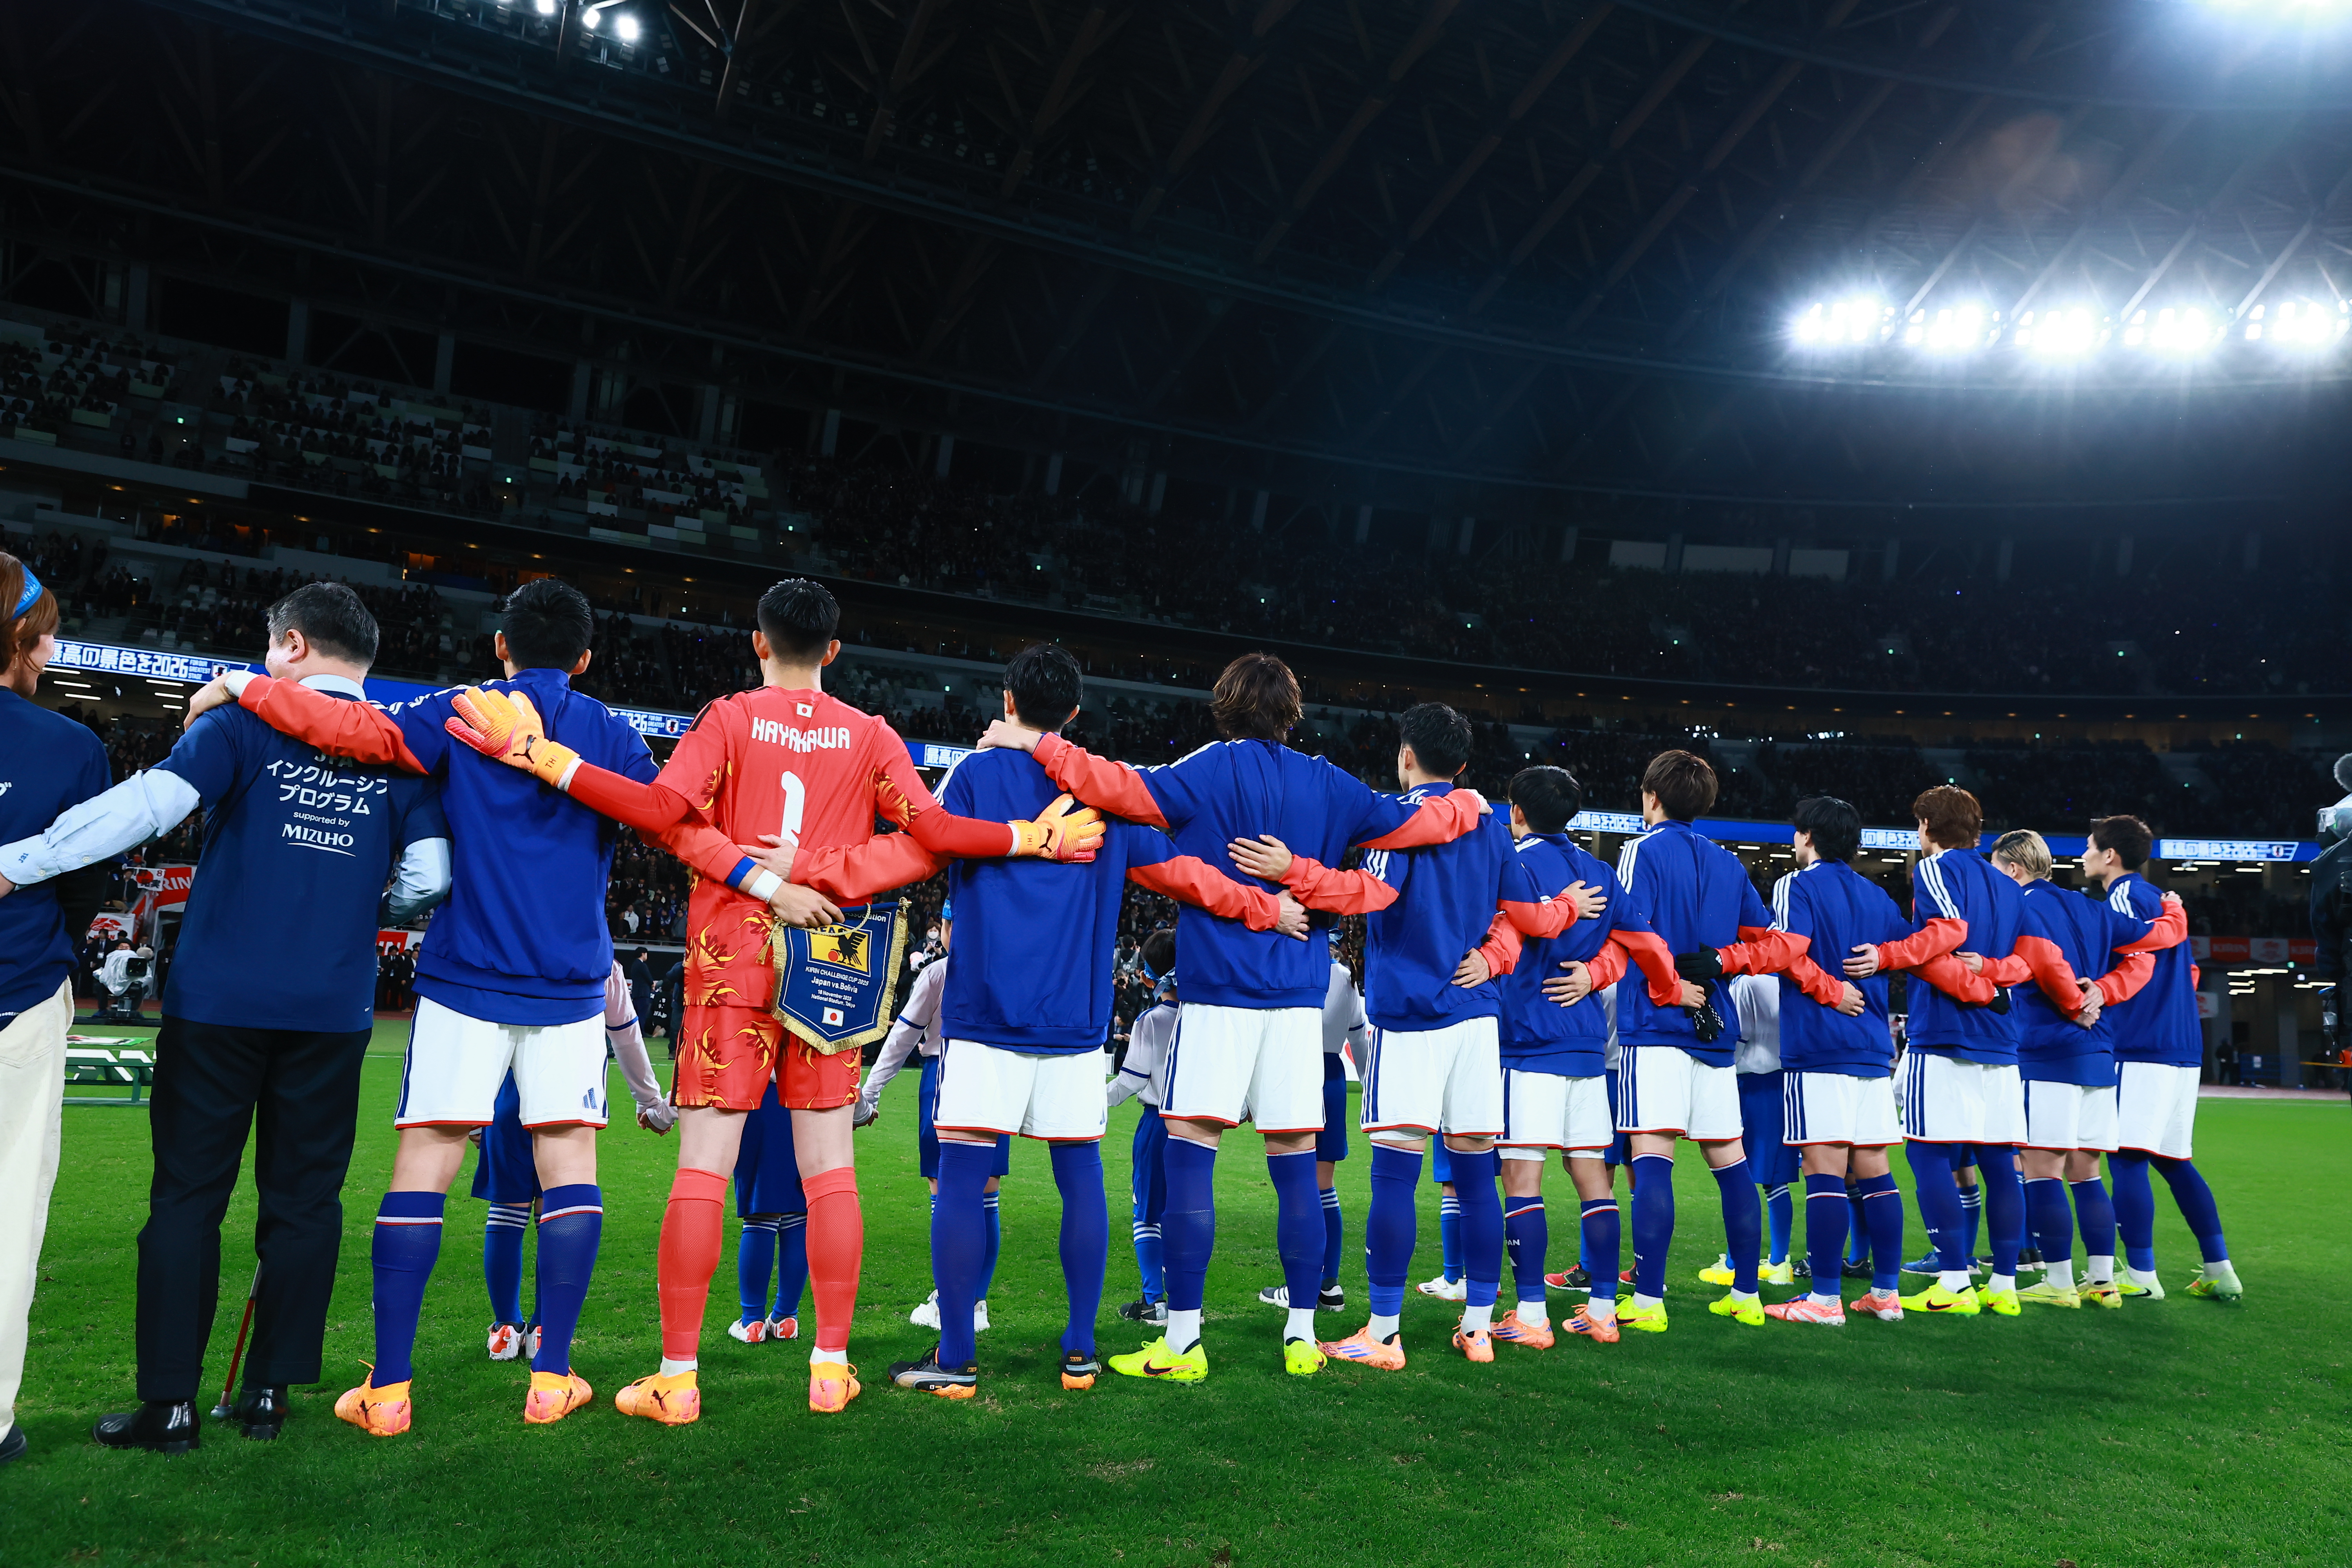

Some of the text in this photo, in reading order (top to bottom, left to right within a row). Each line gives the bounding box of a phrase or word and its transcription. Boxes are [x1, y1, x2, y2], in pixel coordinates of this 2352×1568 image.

[751, 717, 850, 753] HAYAKAWA
[279, 784, 370, 815] プログラム
[293, 811, 350, 827] supported by
[780, 771, 806, 849] 1
[282, 823, 354, 847] MIZUHO
[811, 976, 831, 987] Japan
[820, 970, 848, 981] CHALLENGE
[823, 990, 843, 999] November
